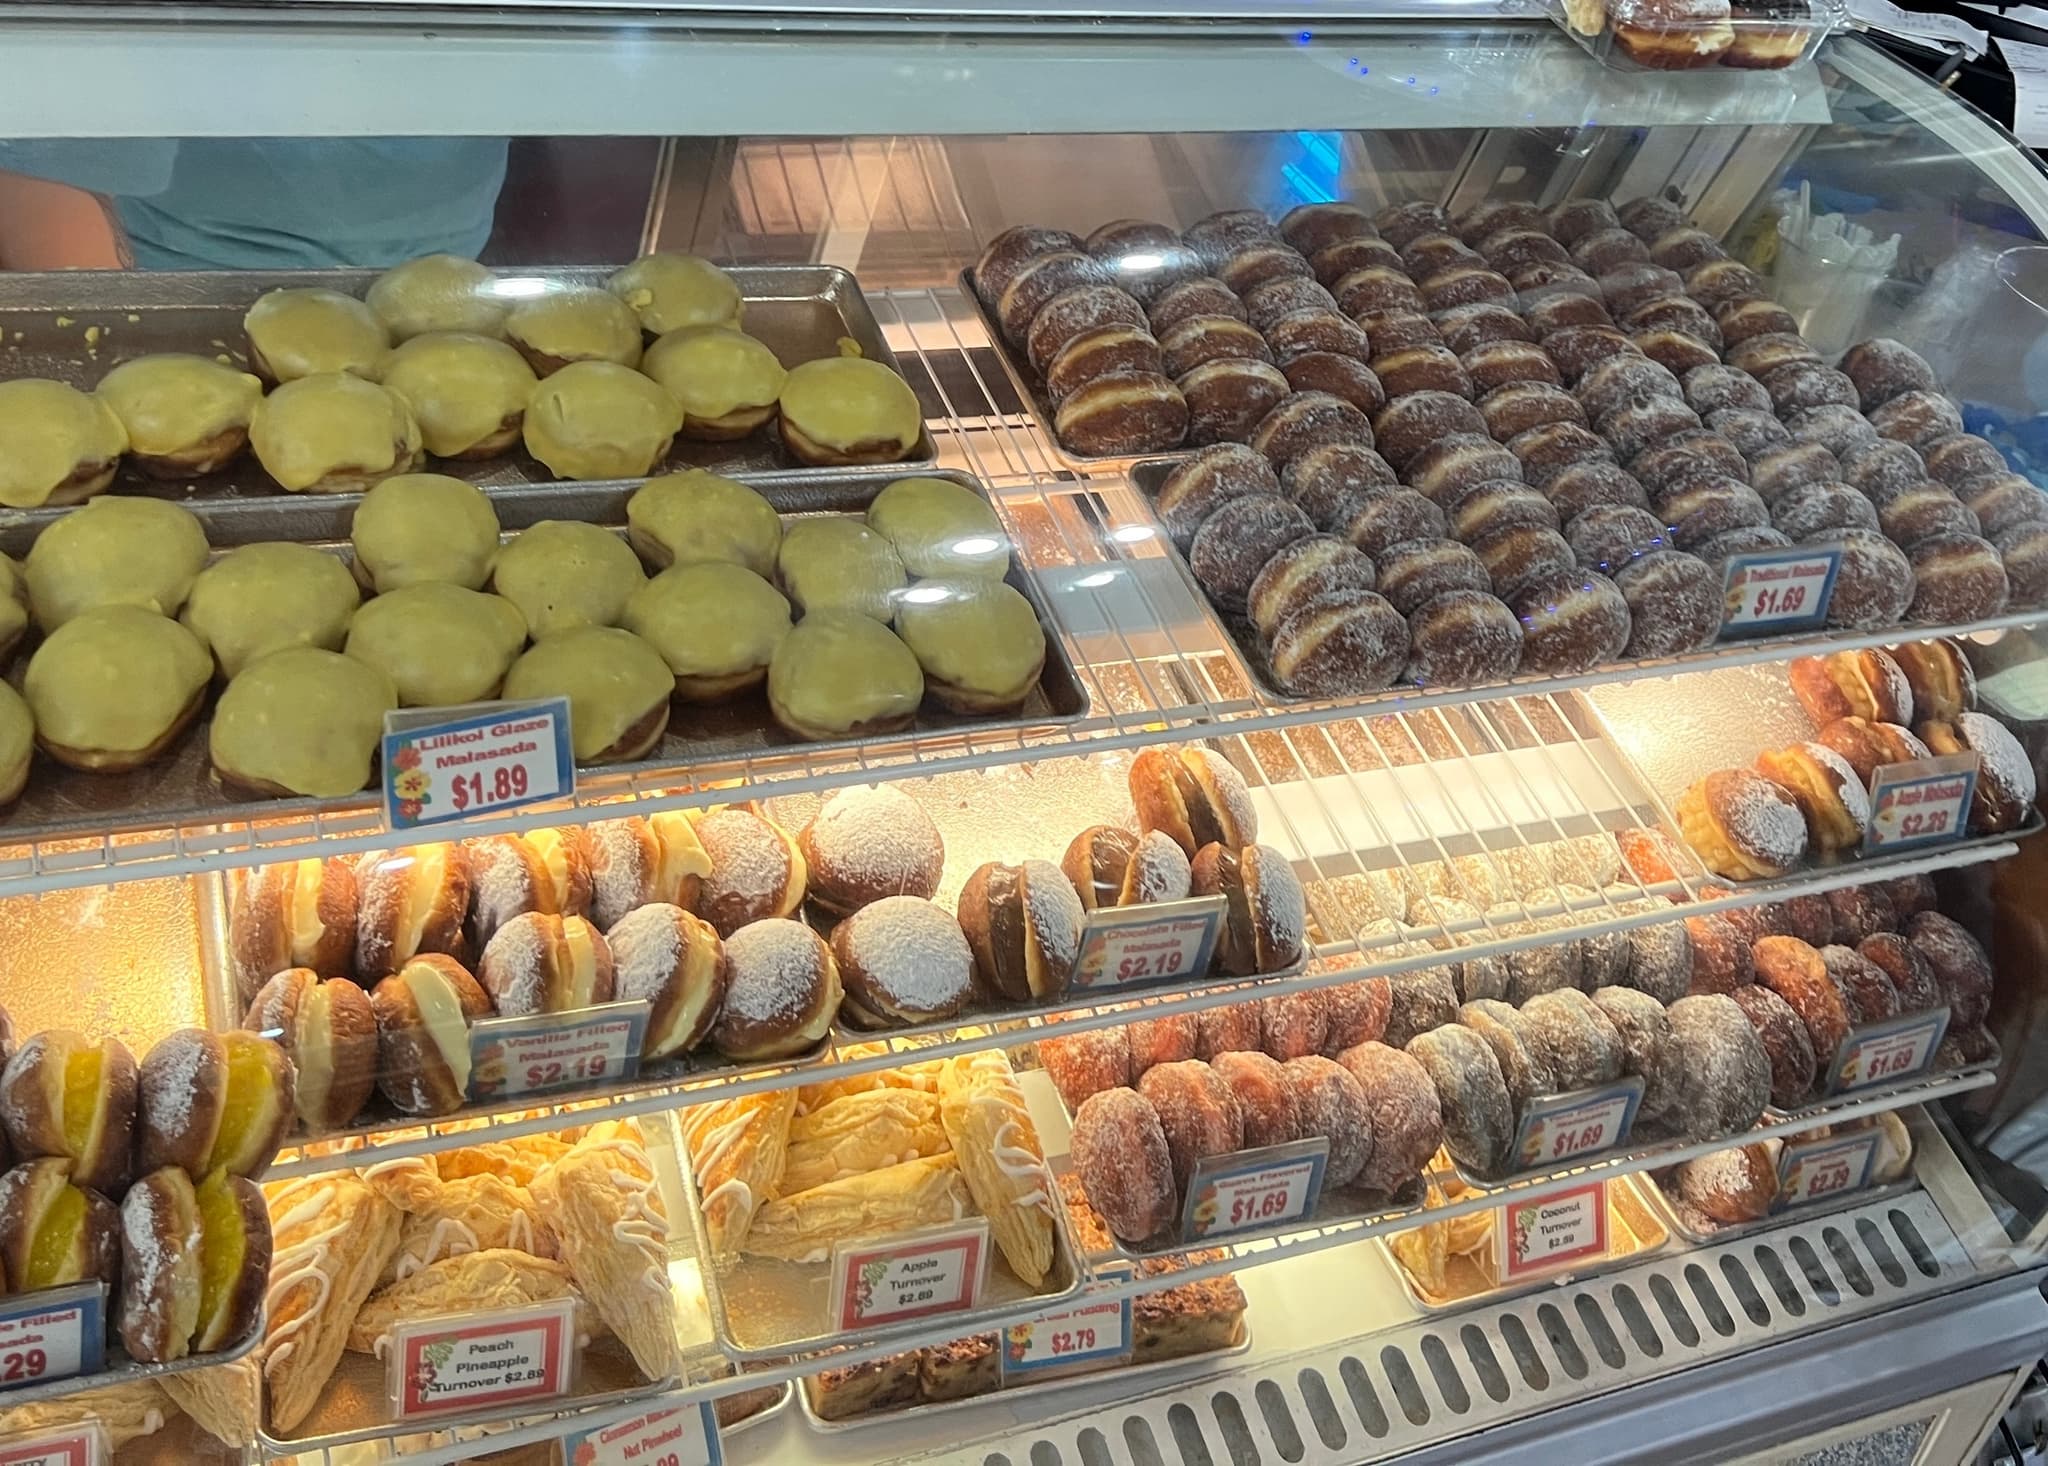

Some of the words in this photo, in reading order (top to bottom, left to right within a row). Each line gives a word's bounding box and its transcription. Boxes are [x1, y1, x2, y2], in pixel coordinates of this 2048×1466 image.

[1754, 585, 1806, 618] $1.69
[491, 718, 550, 738] Glaze
[436, 741, 537, 769] Malasada
[452, 764, 529, 812] $1.89
[1900, 809, 1949, 838] $2.29
[1107, 924, 1169, 941] Chocolate
[1117, 951, 1183, 981] $2.19
[576, 1022, 630, 1040] Filled
[519, 1042, 610, 1063] Malasada
[1867, 1048, 1914, 1080] $1.69
[525, 1054, 608, 1088] $2.19
[1553, 1123, 1604, 1158] $1.69
[1230, 1190, 1288, 1225] $1.69
[1541, 1202, 1581, 1219] Coconut
[1541, 1217, 1583, 1235] Turnover
[901, 1258, 938, 1273] Apple
[889, 1272, 947, 1291] Turnover
[21, 1310, 77, 1328] Filled
[468, 1339, 514, 1355] Peach
[1052, 1328, 1096, 1355] $2.79
[456, 1355, 529, 1374] Pineapple
[433, 1375, 500, 1393] Turnover
[504, 1368, 545, 1384] $2.89
